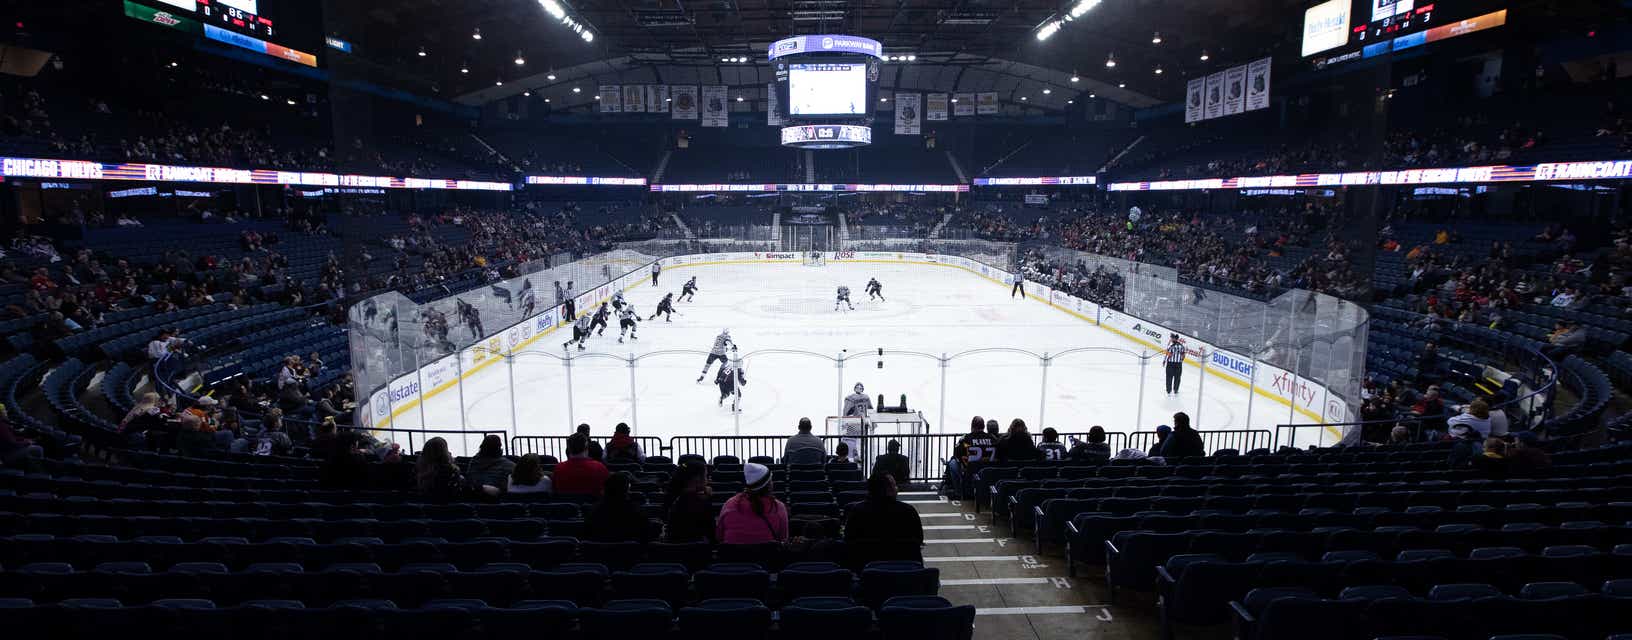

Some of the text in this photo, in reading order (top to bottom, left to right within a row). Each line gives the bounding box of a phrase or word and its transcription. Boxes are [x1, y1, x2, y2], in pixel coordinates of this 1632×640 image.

[3, 159, 103, 179] CHICAGO WOLVES
[163, 166, 211, 181] RAINCOAT
[1555, 161, 1632, 178] RAINCOAT
[1213, 351, 1230, 367] BUD
[1271, 371, 1317, 408] xfinity
[967, 447, 997, 463] 27
[964, 513, 976, 521] D
[978, 525, 991, 533] E
[1022, 555, 1038, 565] G
[1051, 577, 1072, 589] H
[1096, 608, 1113, 622] J
